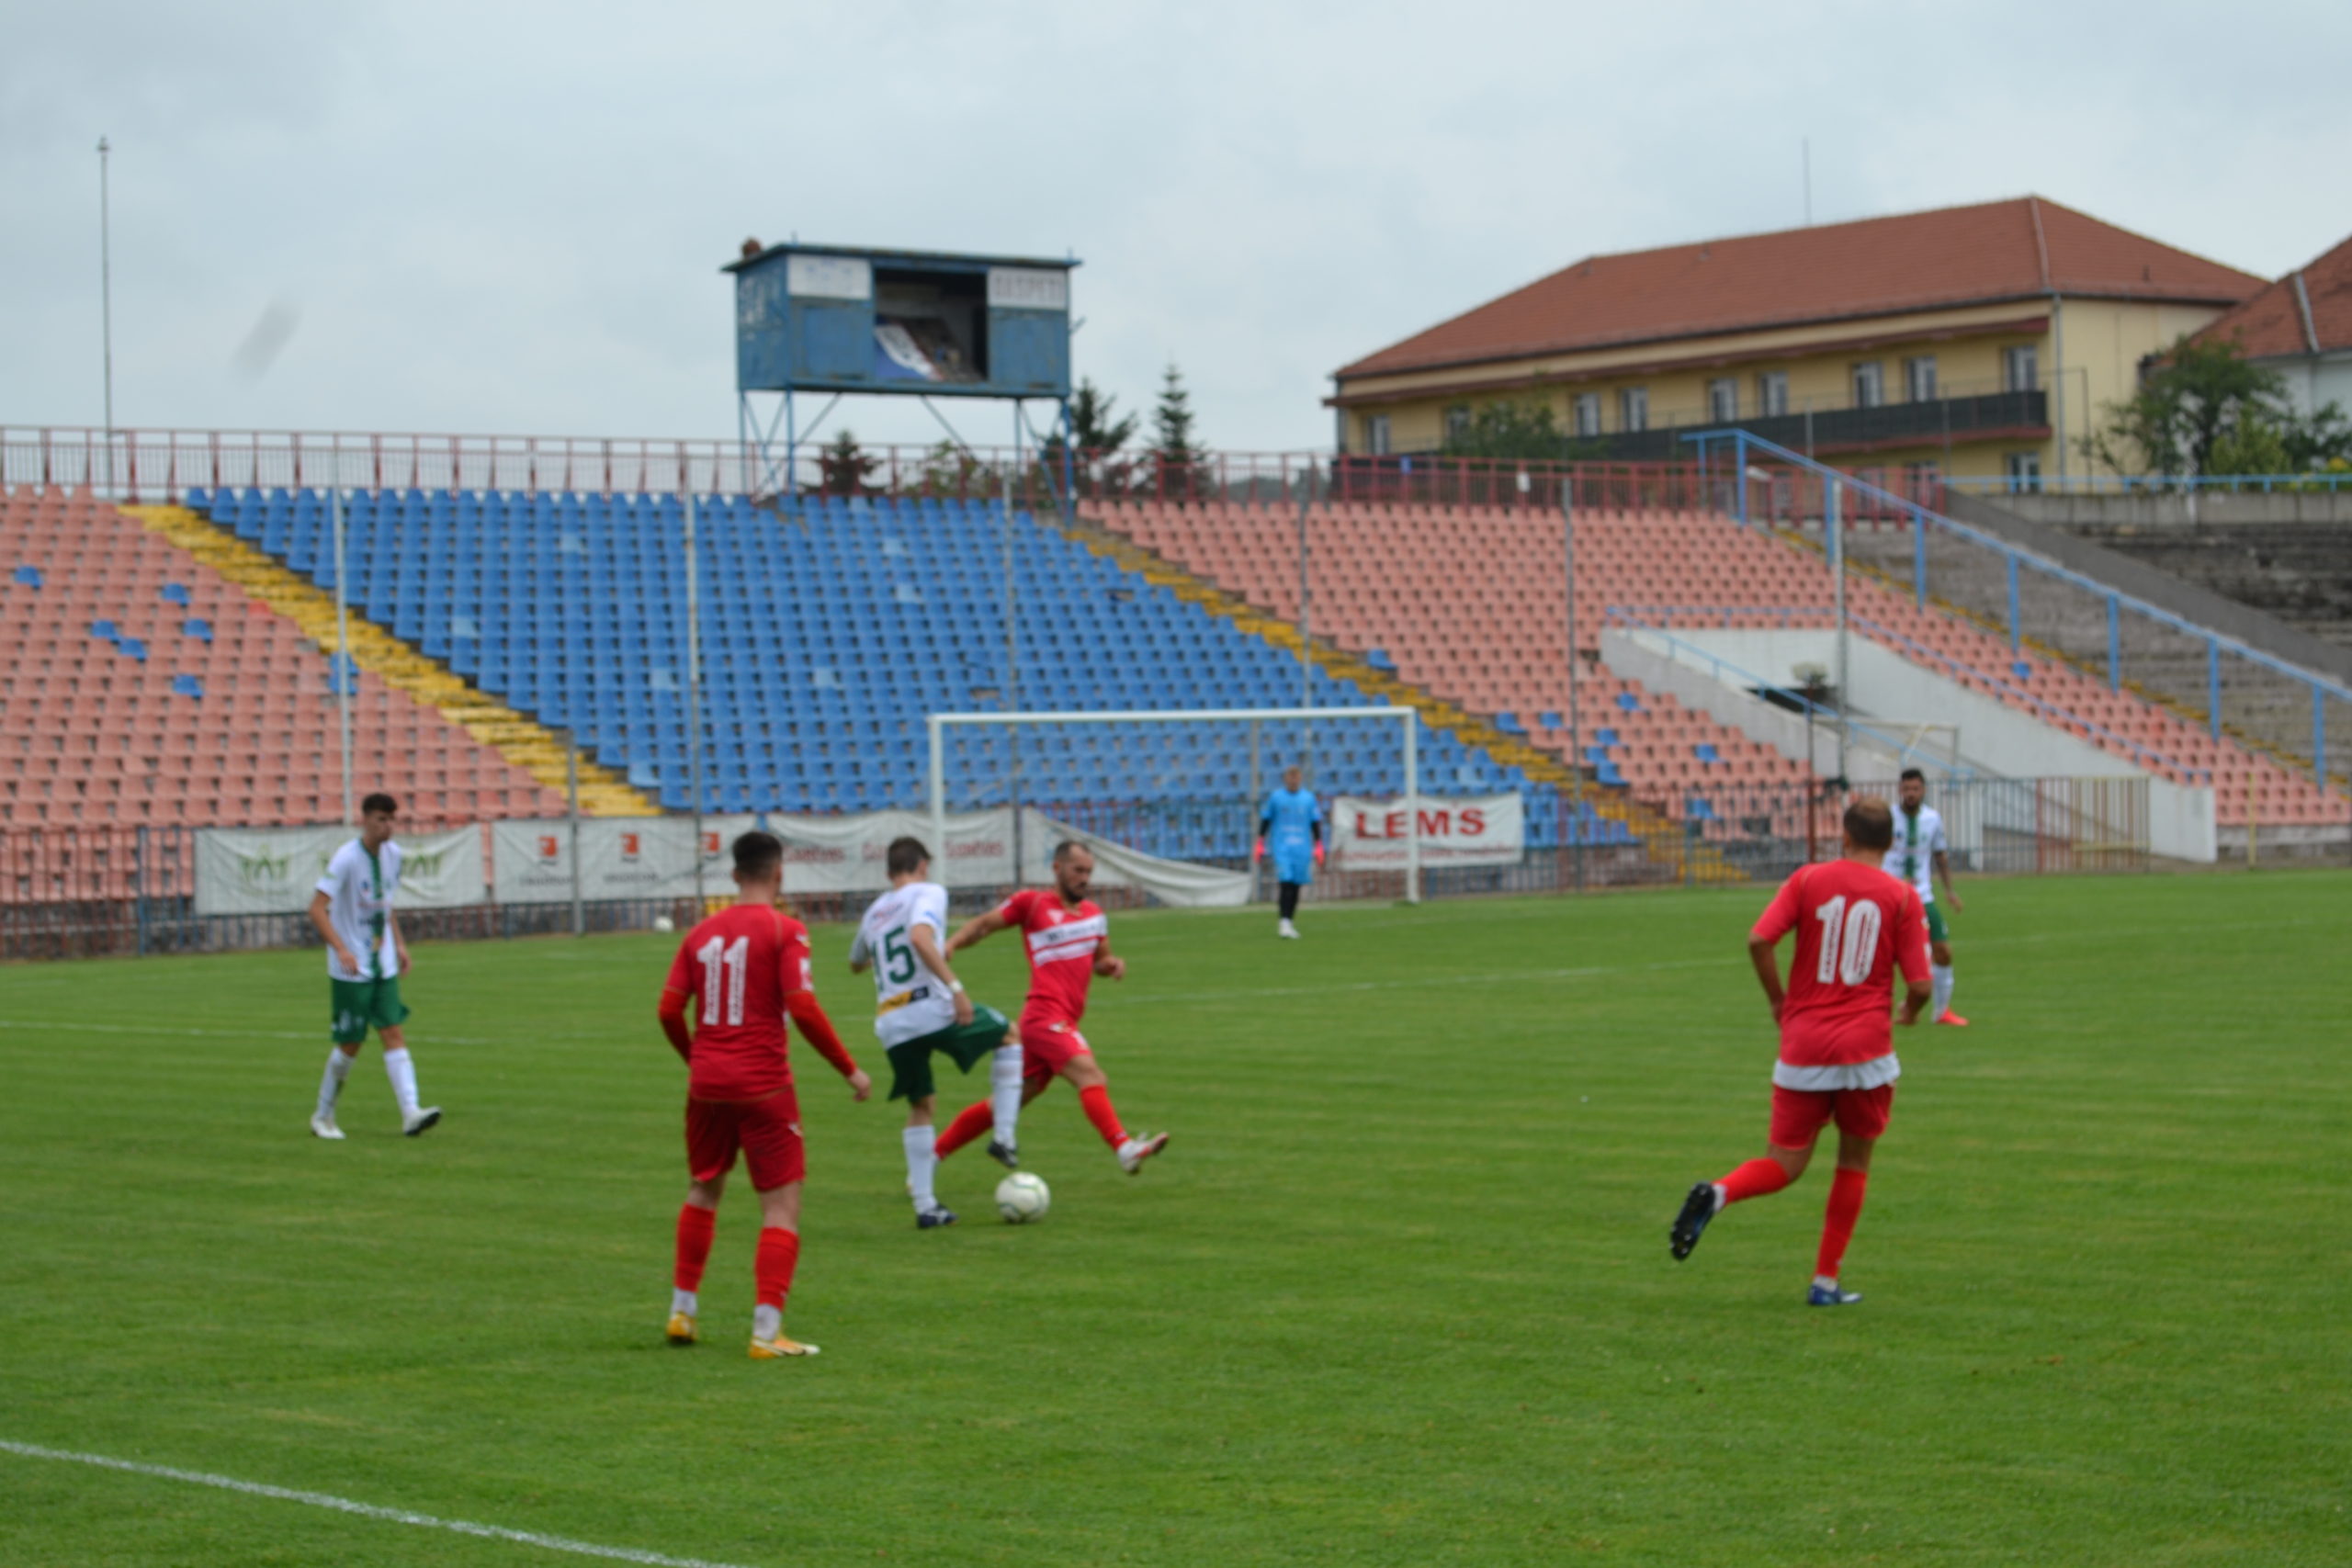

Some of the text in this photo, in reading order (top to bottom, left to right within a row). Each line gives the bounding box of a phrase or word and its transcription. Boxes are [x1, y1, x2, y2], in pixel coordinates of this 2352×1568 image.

[696, 935, 749, 1026] 11
[873, 925, 916, 992] 15
[1815, 895, 1882, 987] 10
